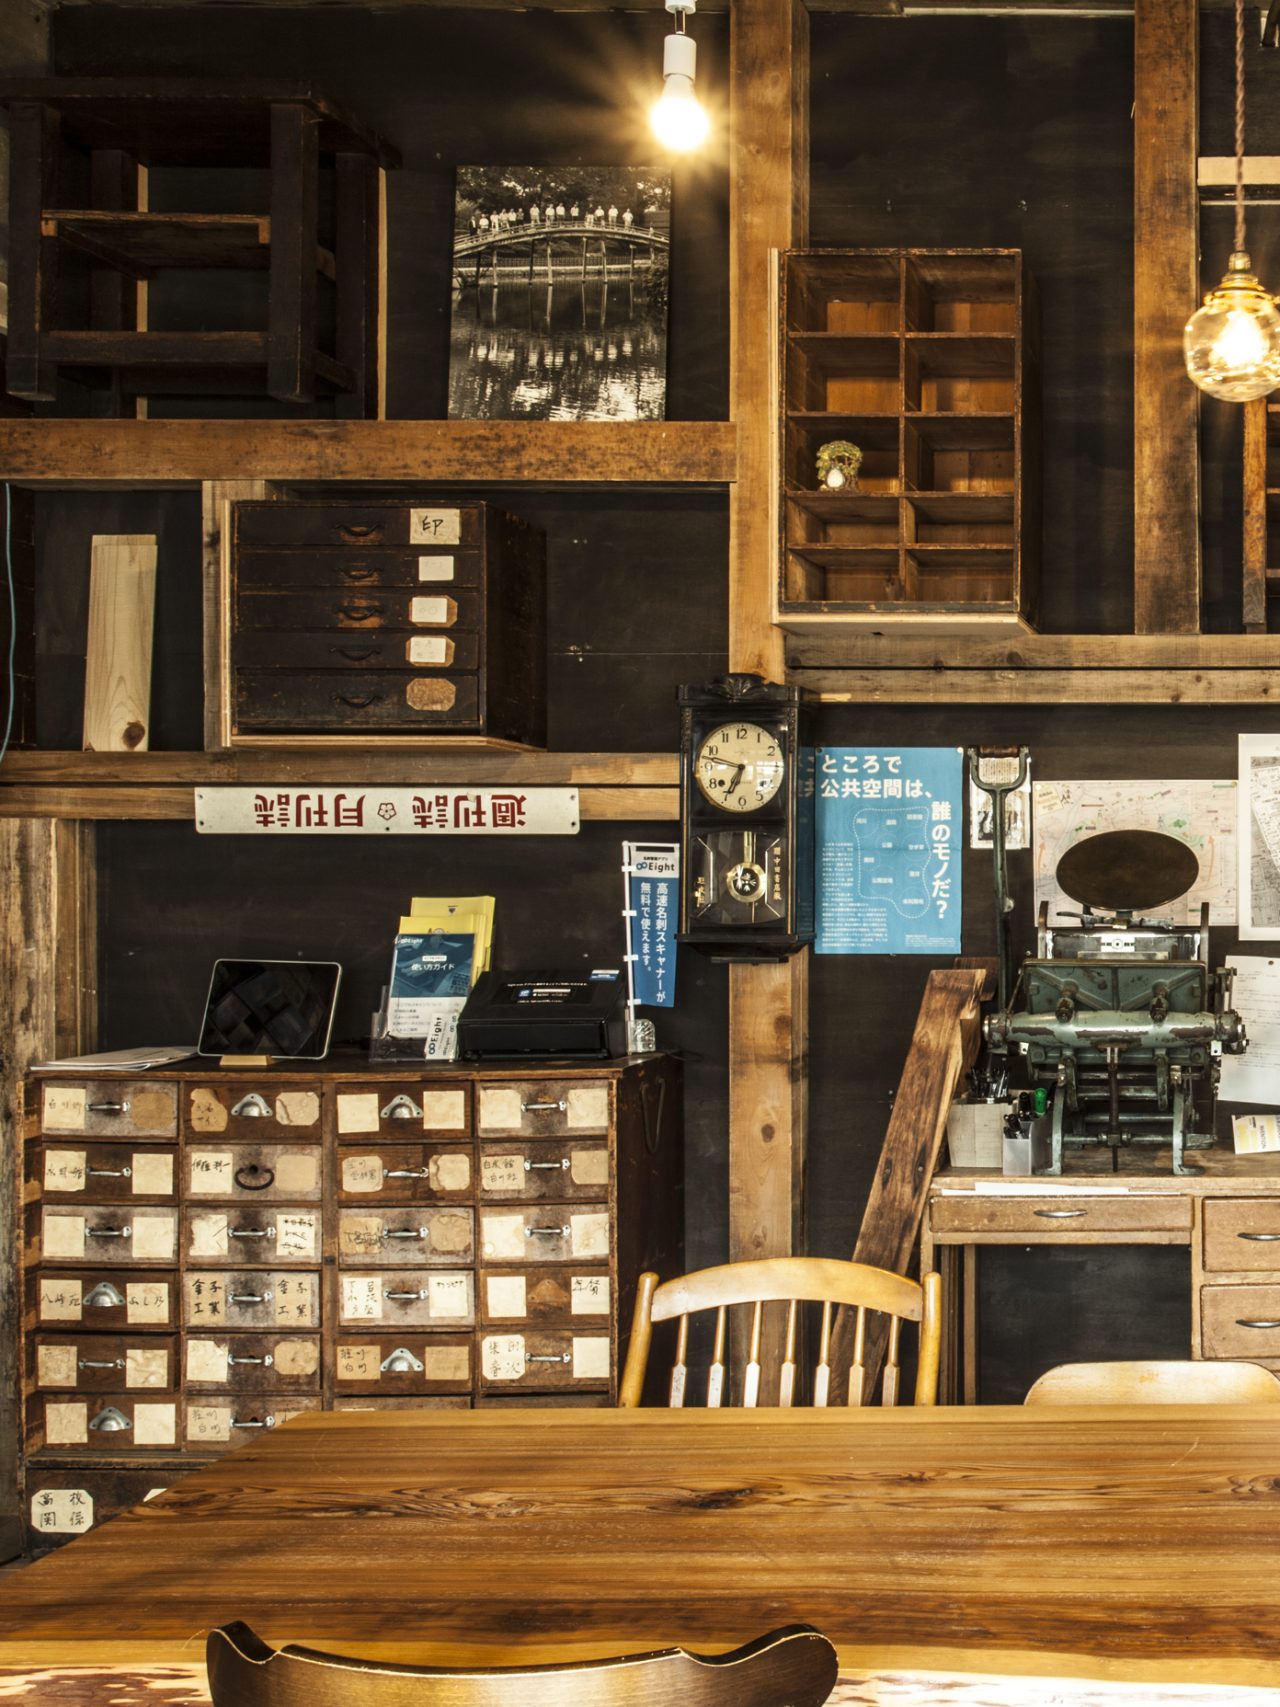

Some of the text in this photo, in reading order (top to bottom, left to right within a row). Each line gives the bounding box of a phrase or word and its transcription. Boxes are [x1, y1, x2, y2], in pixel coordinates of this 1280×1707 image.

[721, 732, 729, 743] 11
[736, 728, 748, 740] 12
[757, 732, 761, 744] 1
[708, 745, 719, 756] 10
[767, 746, 776, 757] 2
[821, 755, 902, 774] ところで
[709, 778, 718, 789] 8
[821, 778, 933, 799] 公共空間は、
[738, 796, 747, 807] 6
[755, 790, 764, 802] 5
[254, 793, 528, 829] 週刊誌 月刊誌
[648, 862, 676, 873] Eight
[640, 882, 652, 972] 無料で使えます。
[655, 882, 669, 1003] 高速名刺スキャナーが
[432, 1017, 442, 1043] Eight
